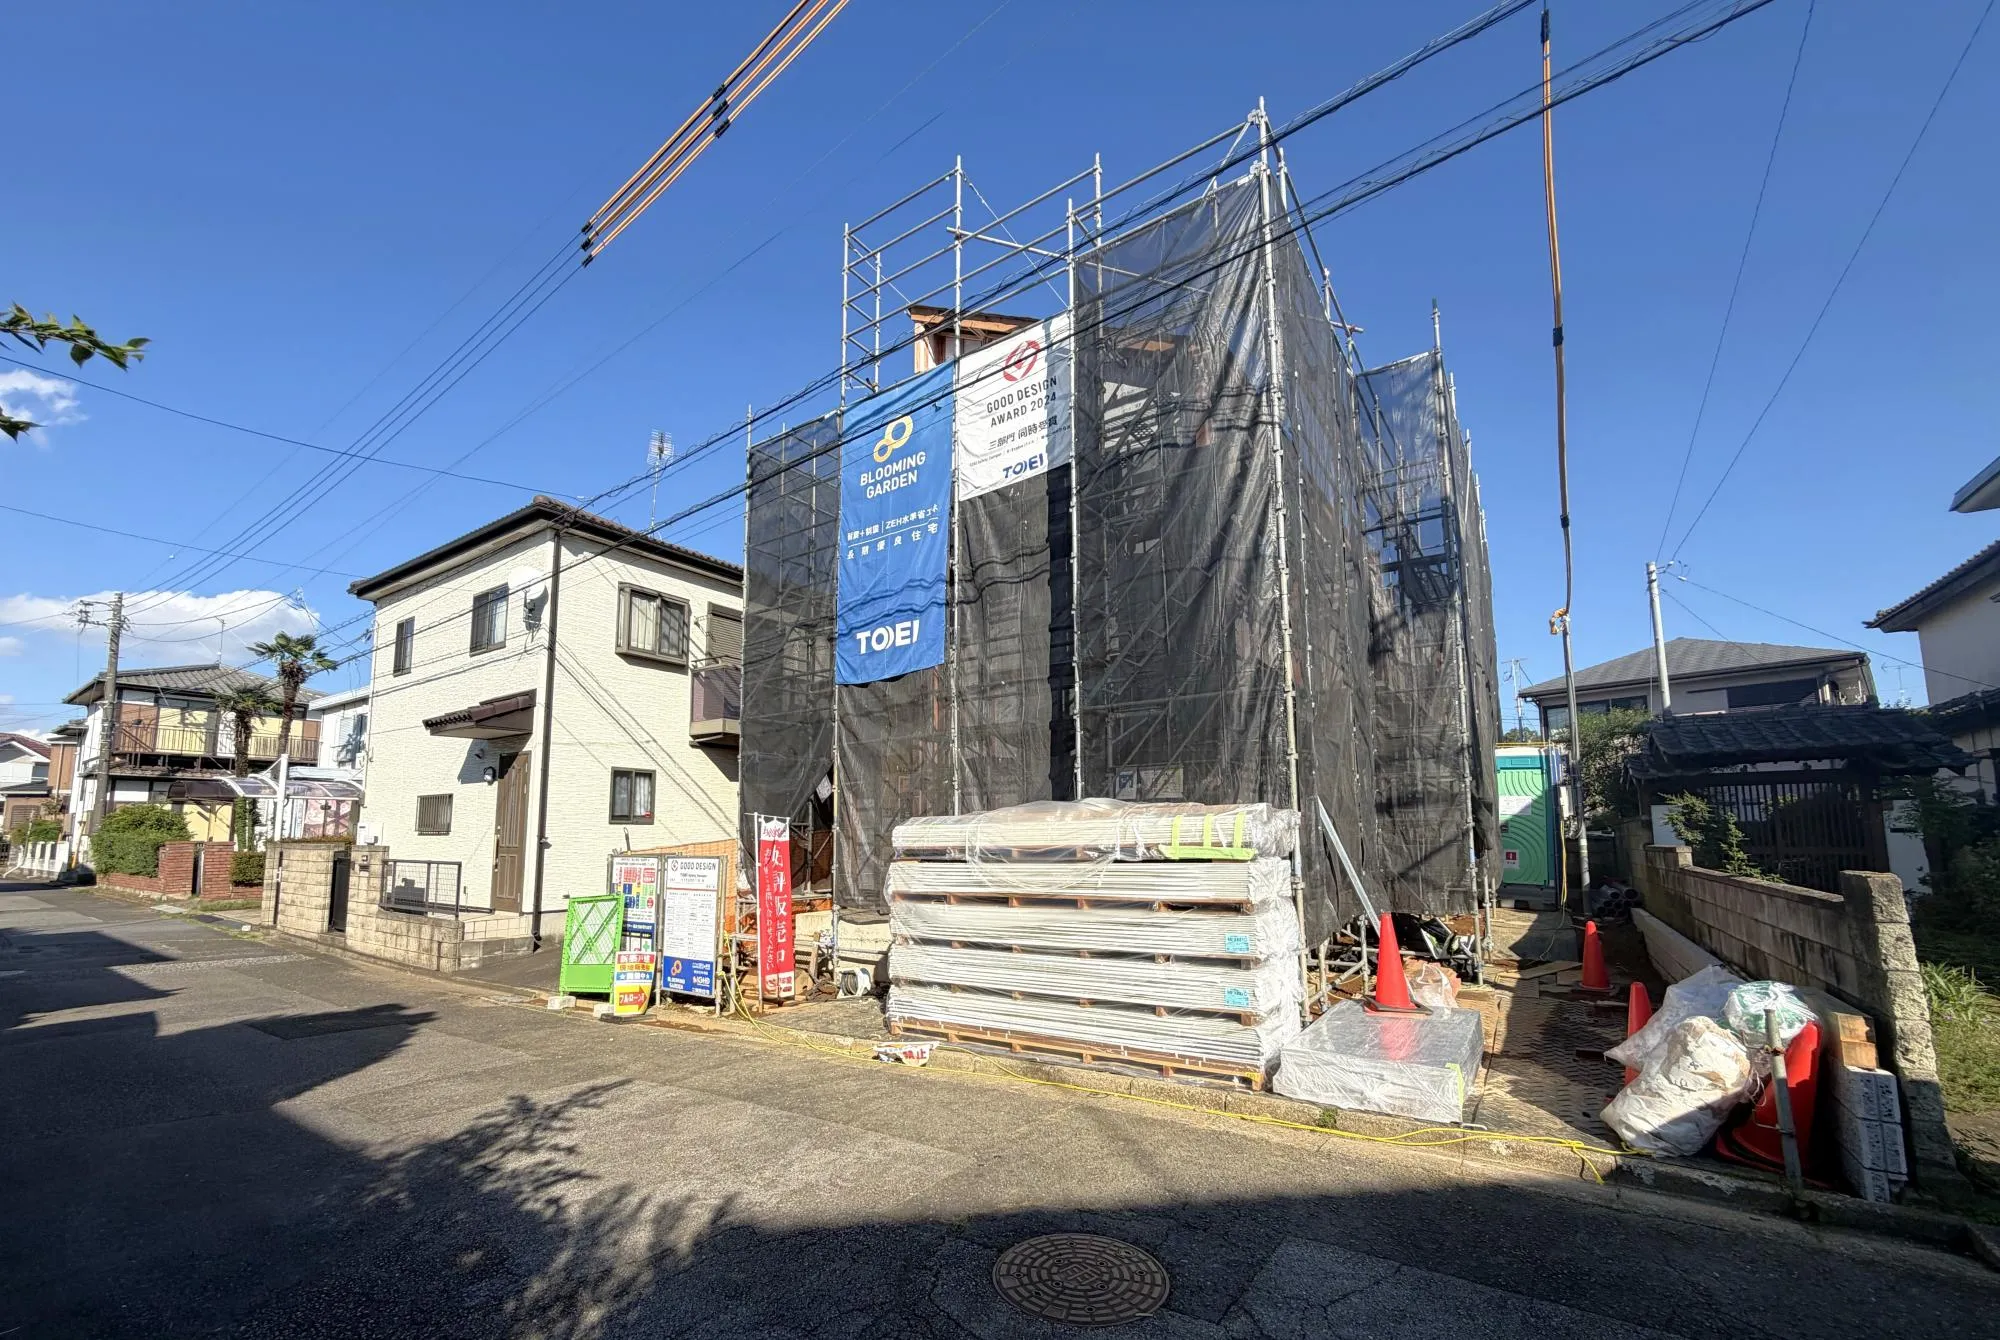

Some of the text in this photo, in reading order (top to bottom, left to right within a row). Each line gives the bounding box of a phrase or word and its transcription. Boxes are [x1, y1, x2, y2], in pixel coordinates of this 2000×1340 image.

[987, 375, 1057, 413] GOOD DESIGN
[990, 391, 1057, 428] AWARD 2024
[860, 451, 926, 486] BLOOMING
[1002, 453, 1044, 478] TOEI
[866, 469, 918, 499] GARDEN
[856, 619, 920, 655] TOEI
[695, 862, 716, 870] DESIGN
